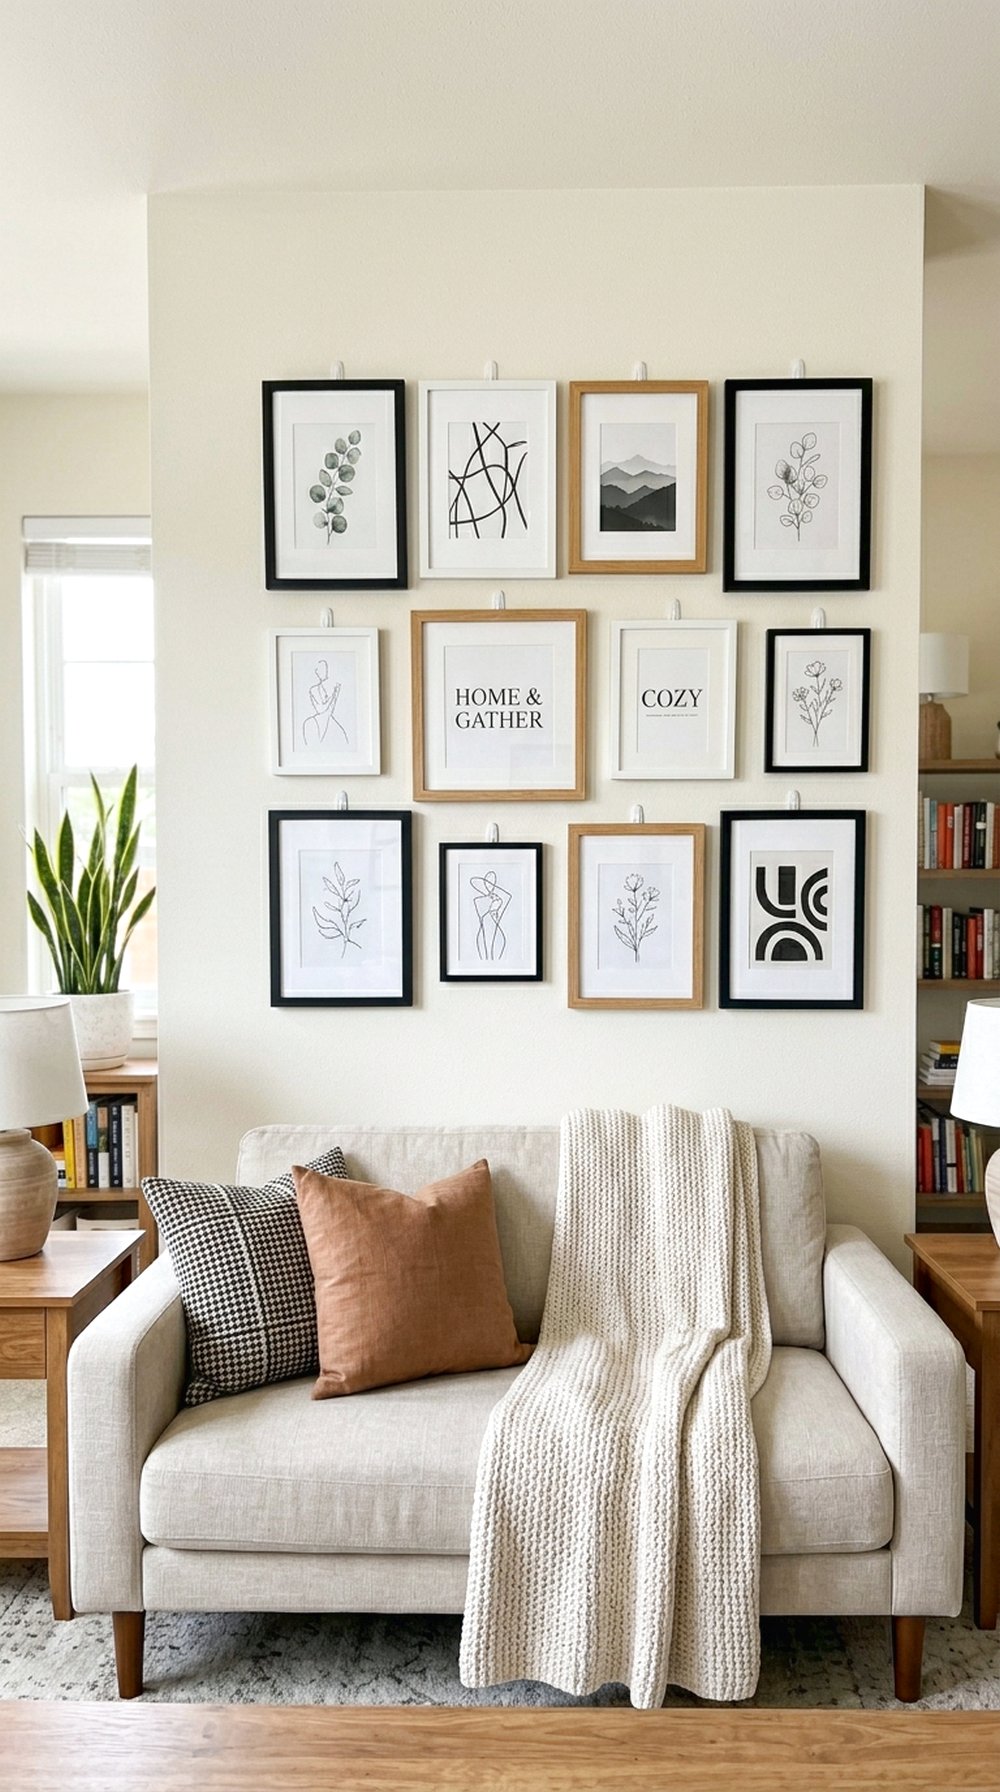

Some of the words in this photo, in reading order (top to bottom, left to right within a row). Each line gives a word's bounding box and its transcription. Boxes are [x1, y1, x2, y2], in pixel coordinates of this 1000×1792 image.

[456, 687, 521, 706] HOME
[526, 687, 543, 706] &
[641, 688, 703, 708] COZY
[455, 710, 544, 729] GATHER
